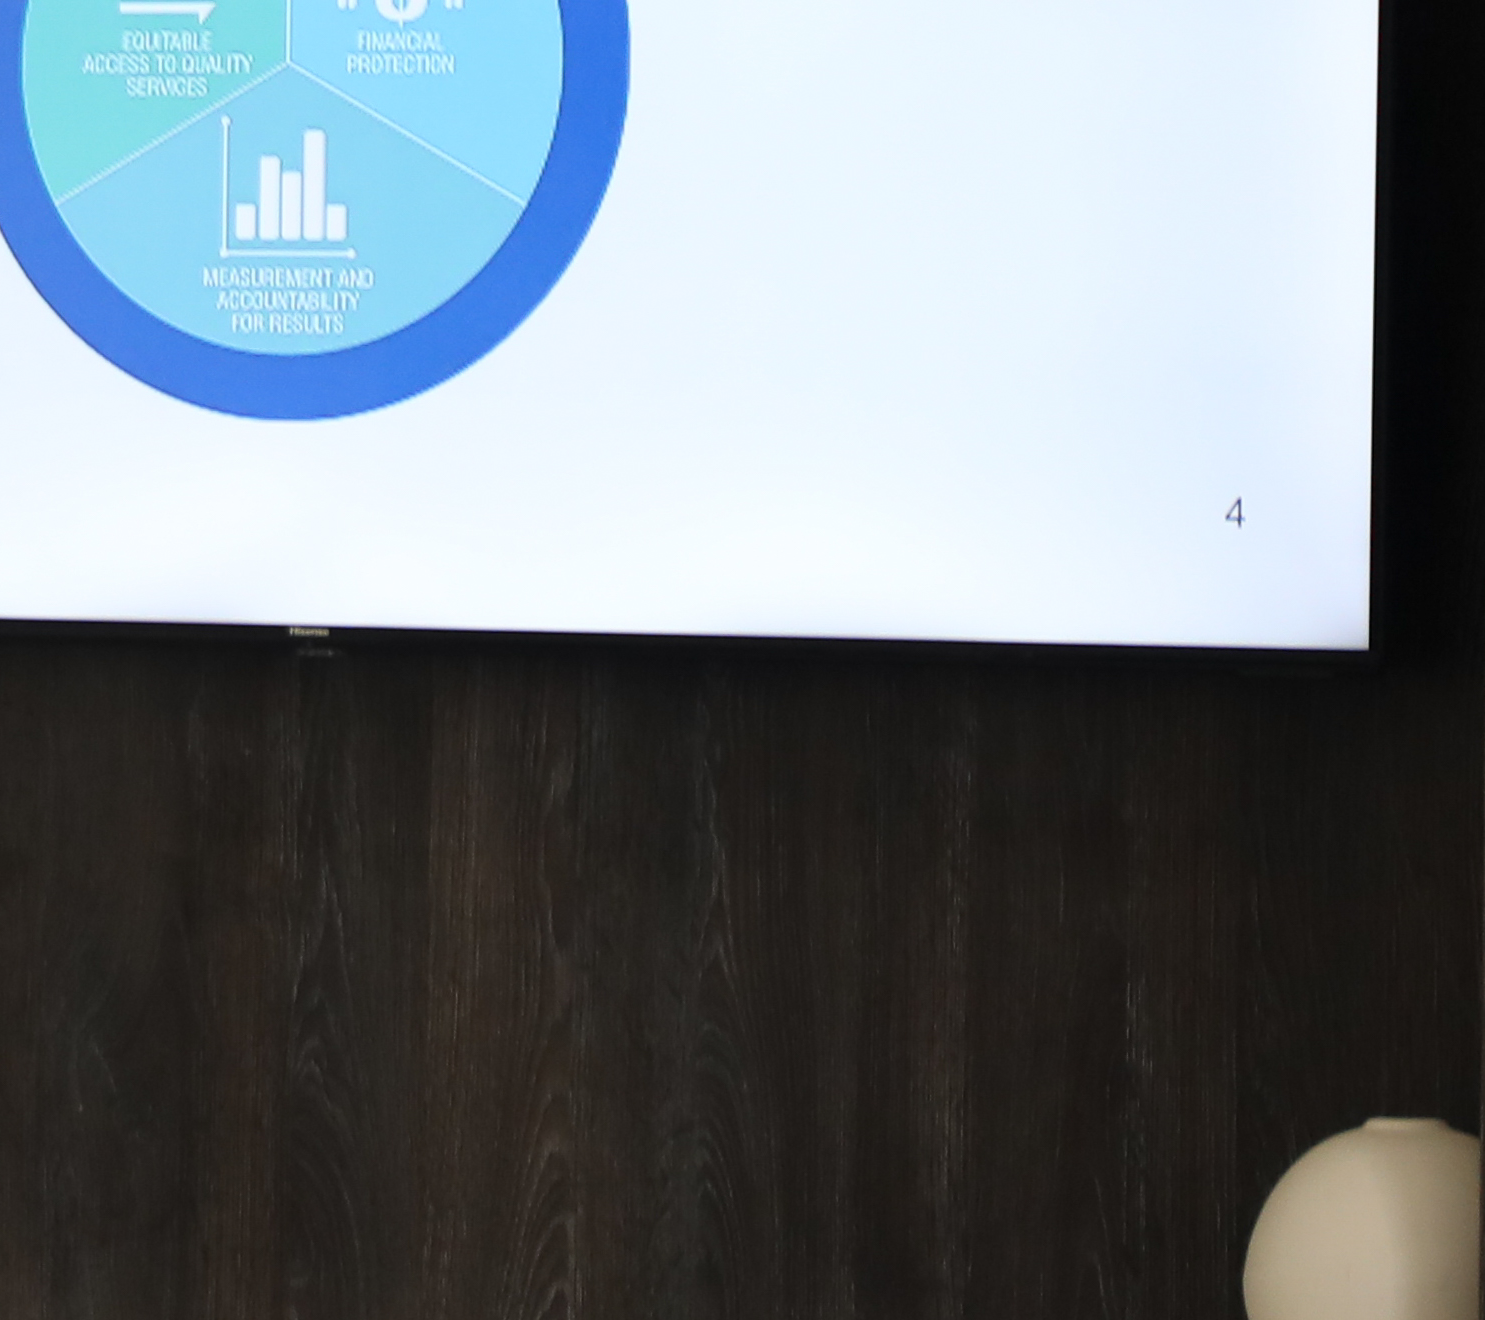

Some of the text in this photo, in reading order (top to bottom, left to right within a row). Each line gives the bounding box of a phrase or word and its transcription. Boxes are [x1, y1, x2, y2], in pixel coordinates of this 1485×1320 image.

[122, 30, 213, 52] EQUITABLE
[358, 30, 444, 52] FINANCIAL
[82, 53, 254, 74] ACCESS TO QUALITY
[347, 53, 455, 75] PROTECTION
[125, 76, 208, 97] SERVICES
[202, 267, 374, 289] MEASUREMENT AND
[216, 290, 360, 311] ACCOUNTABILITY
[232, 312, 344, 333] FOR RESULTS
[1225, 496, 1246, 528] 4
